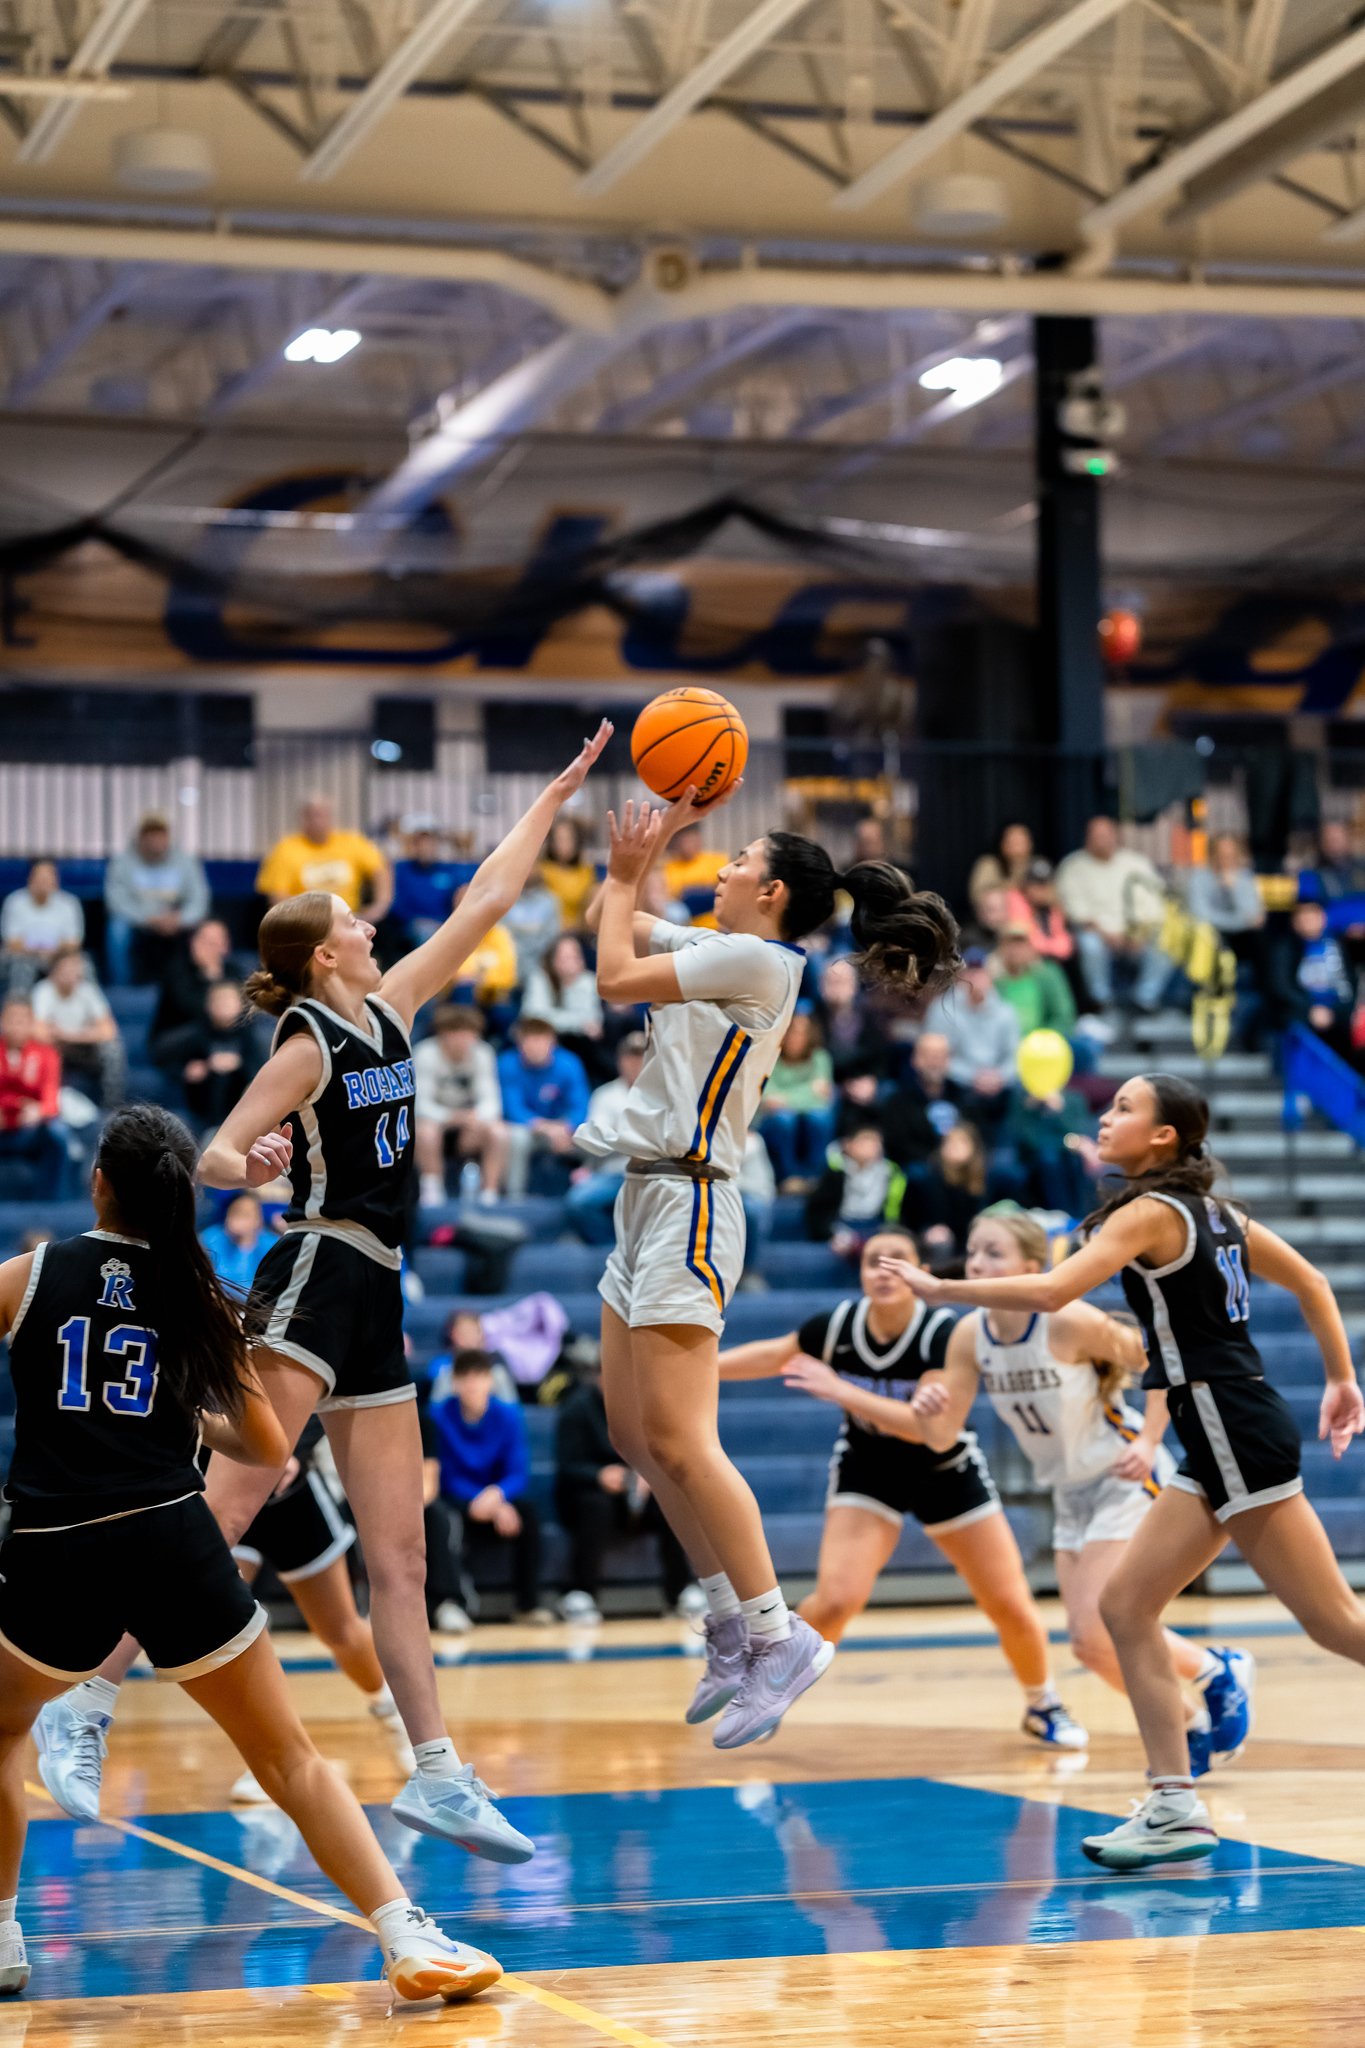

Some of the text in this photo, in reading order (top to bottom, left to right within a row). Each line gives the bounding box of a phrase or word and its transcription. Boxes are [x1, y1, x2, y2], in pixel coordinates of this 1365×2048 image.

[374, 1105, 411, 1169] 14
[97, 1273, 137, 1311] R
[57, 1316, 160, 1418] 13
[1012, 1401, 1052, 1436] 11
